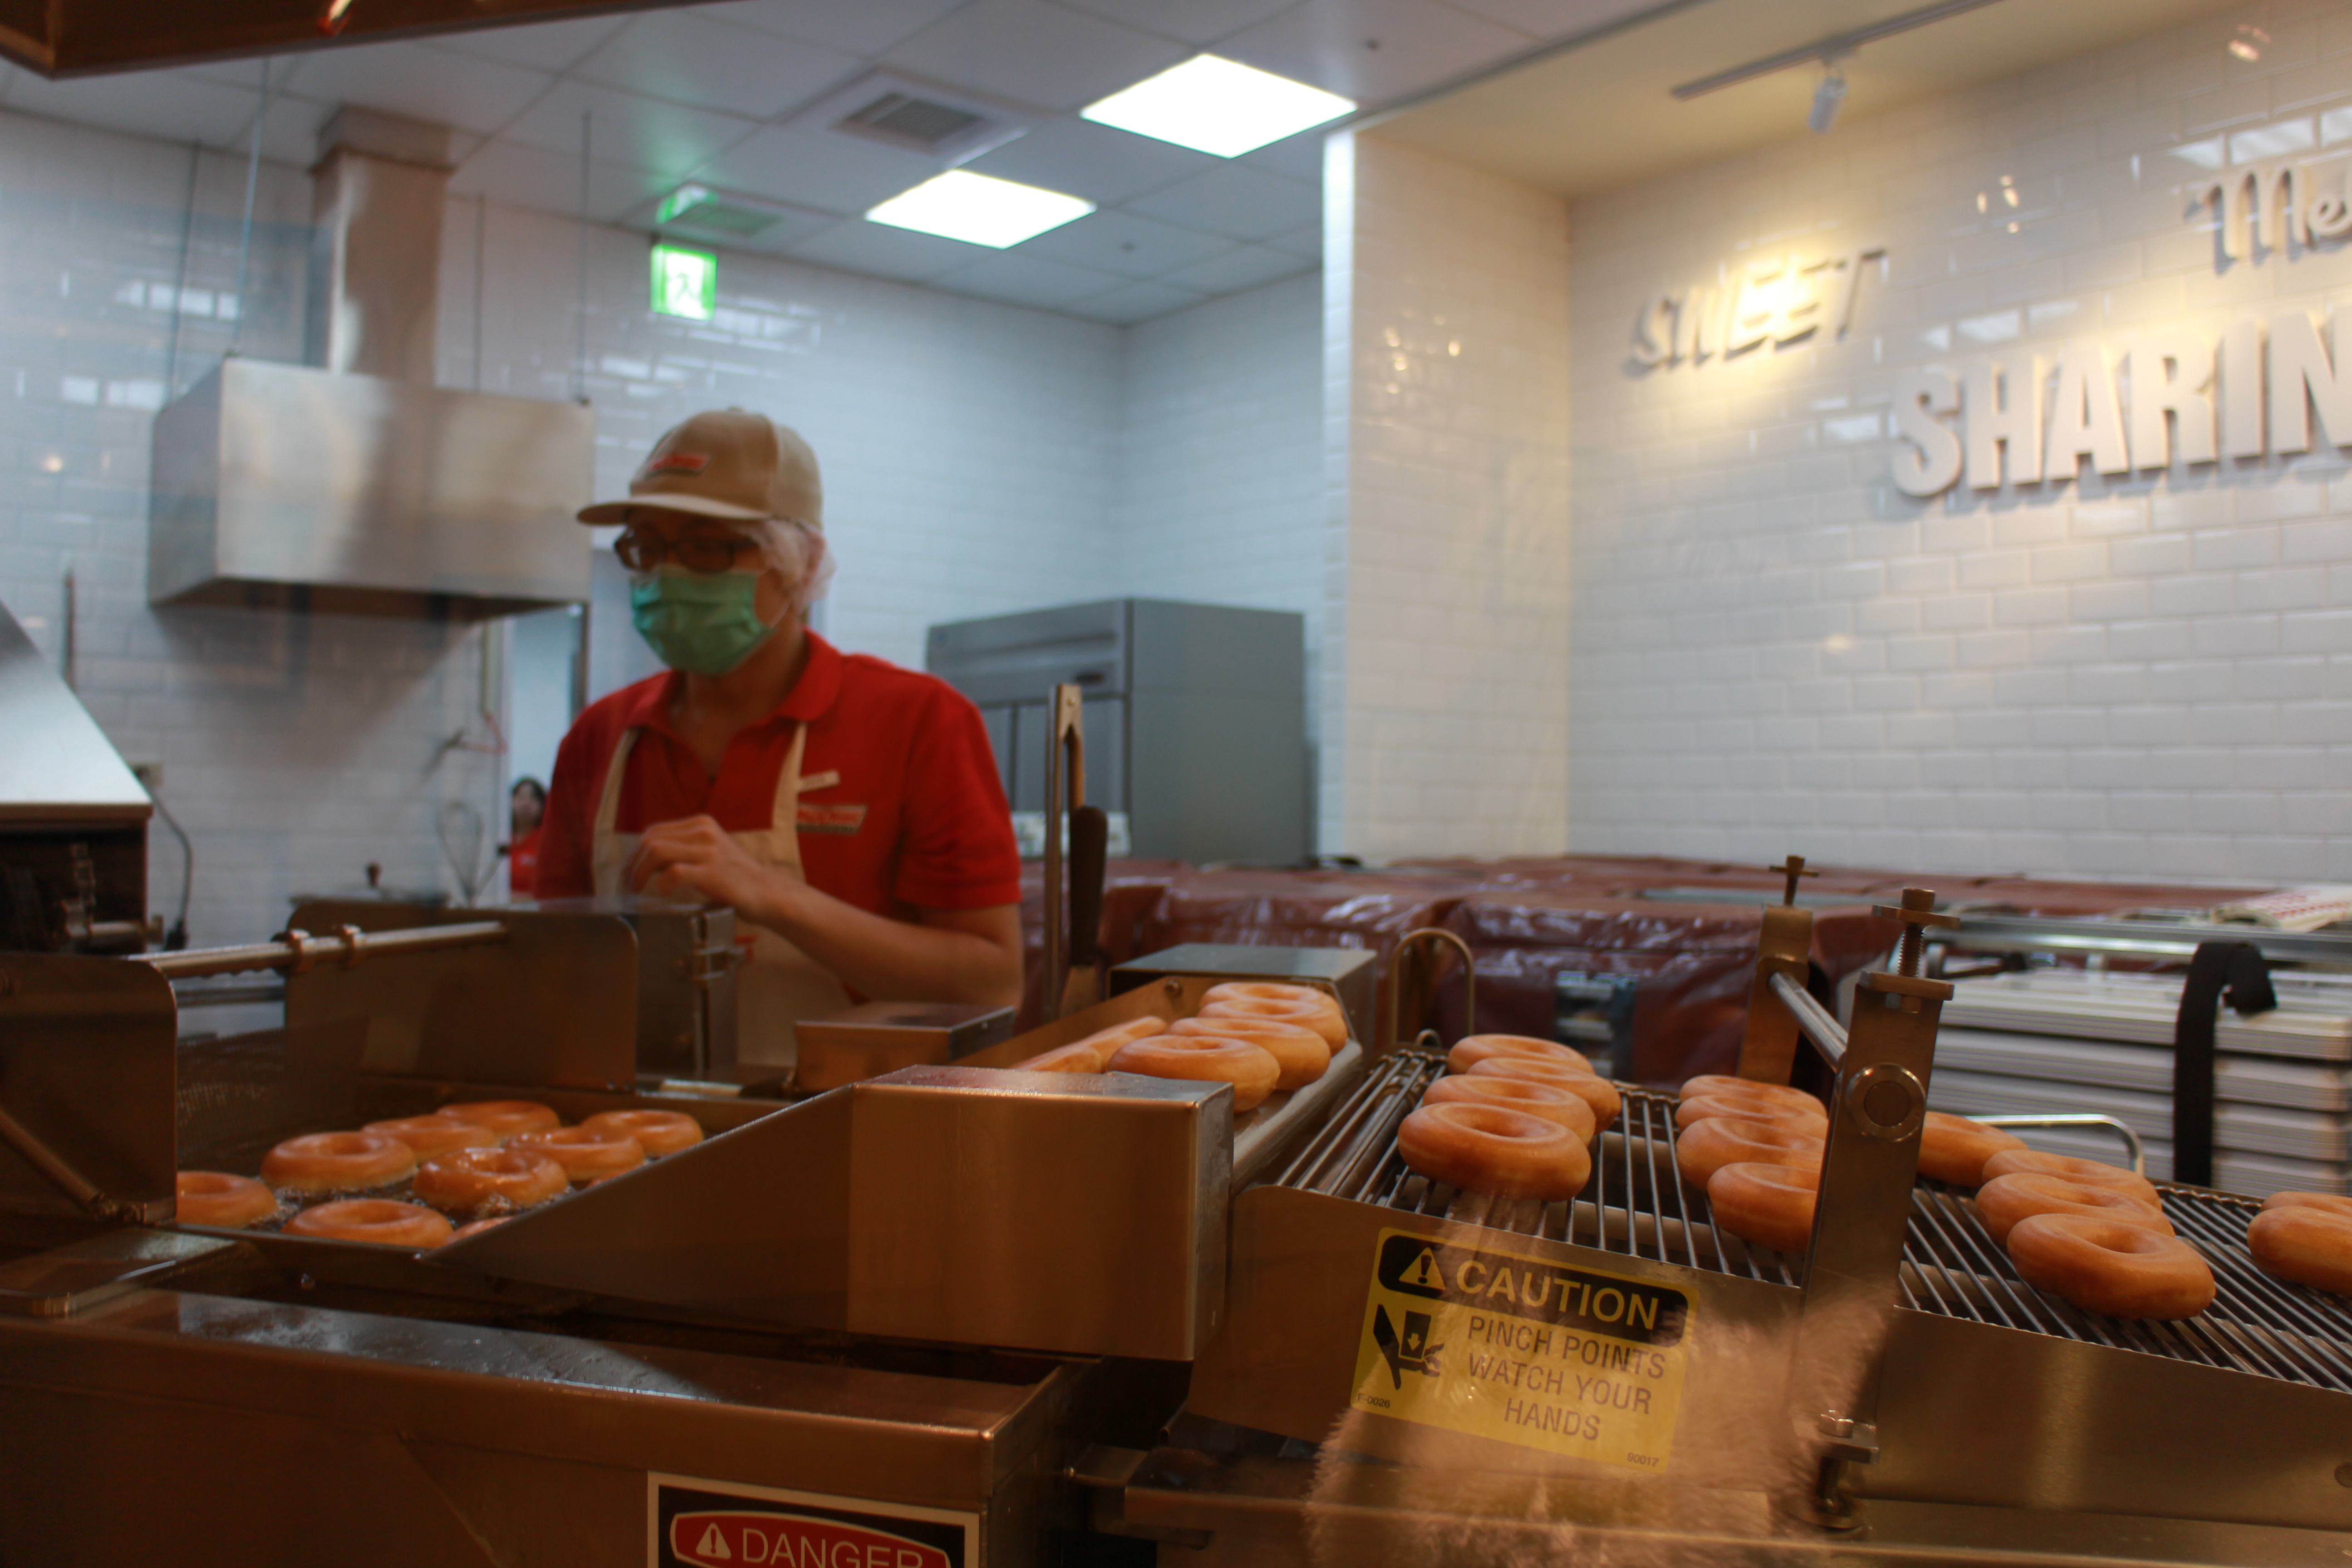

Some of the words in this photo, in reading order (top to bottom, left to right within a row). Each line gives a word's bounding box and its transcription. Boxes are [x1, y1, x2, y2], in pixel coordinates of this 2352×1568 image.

[1630, 247, 1886, 368] SWEET
[1890, 308, 2352, 498] SHARIN
[1457, 1259, 1659, 1330] CAUTION
[1468, 1315, 1553, 1356] PINCH
[1562, 1335, 1666, 1379] POINTS
[1357, 1392, 1391, 1408] F-0026
[1468, 1352, 1564, 1395] WATCH
[1575, 1374, 1652, 1414] YOUR
[1504, 1397, 1600, 1440] HANDS
[1627, 1452, 1660, 1467] 90017
[742, 1528, 923, 1568] DANGER
